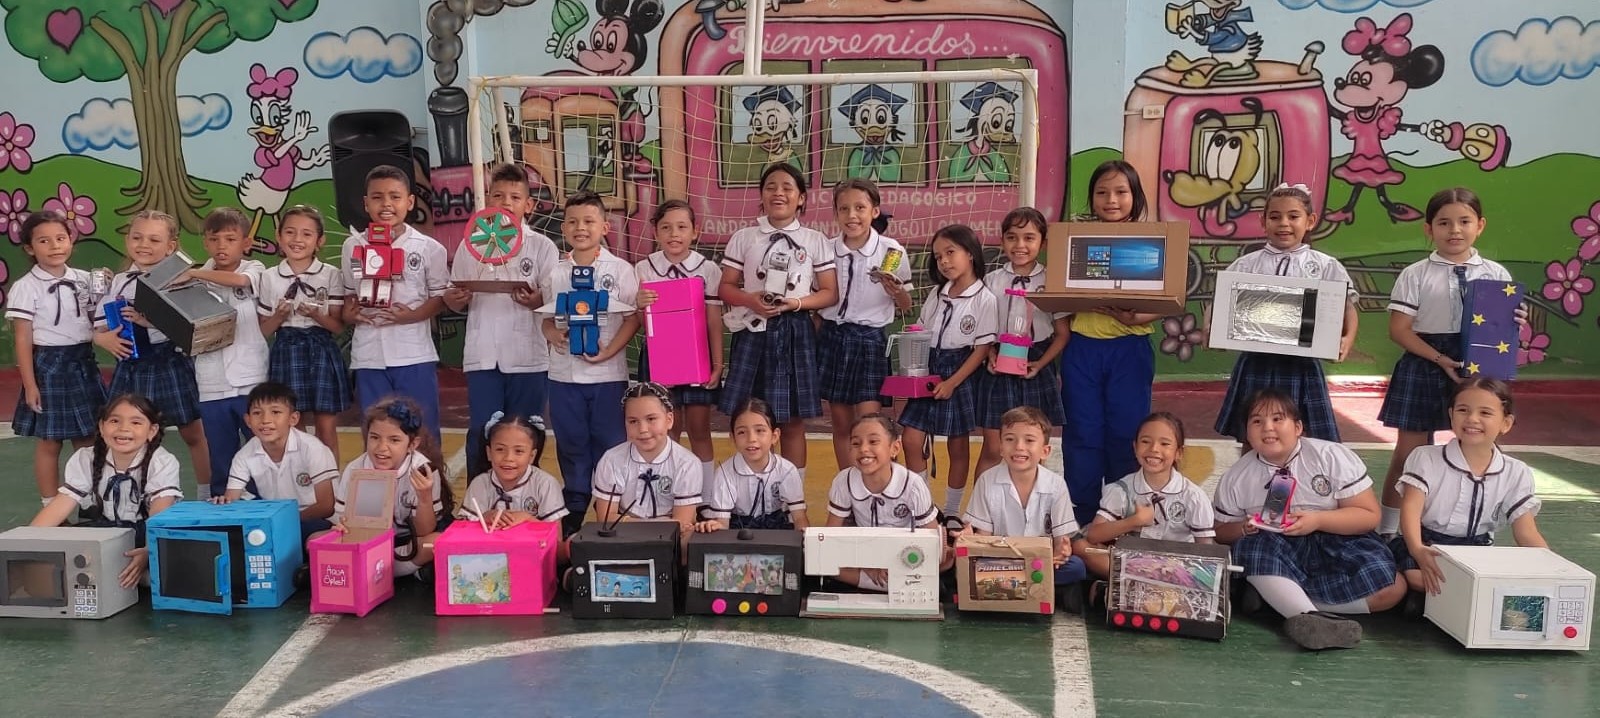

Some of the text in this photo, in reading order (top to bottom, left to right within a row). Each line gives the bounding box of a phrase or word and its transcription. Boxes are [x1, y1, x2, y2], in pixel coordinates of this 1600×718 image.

[878, 190, 977, 206] EDAGOGICO
[703, 219, 758, 235] ANDR
[969, 220, 1003, 237] MEN
